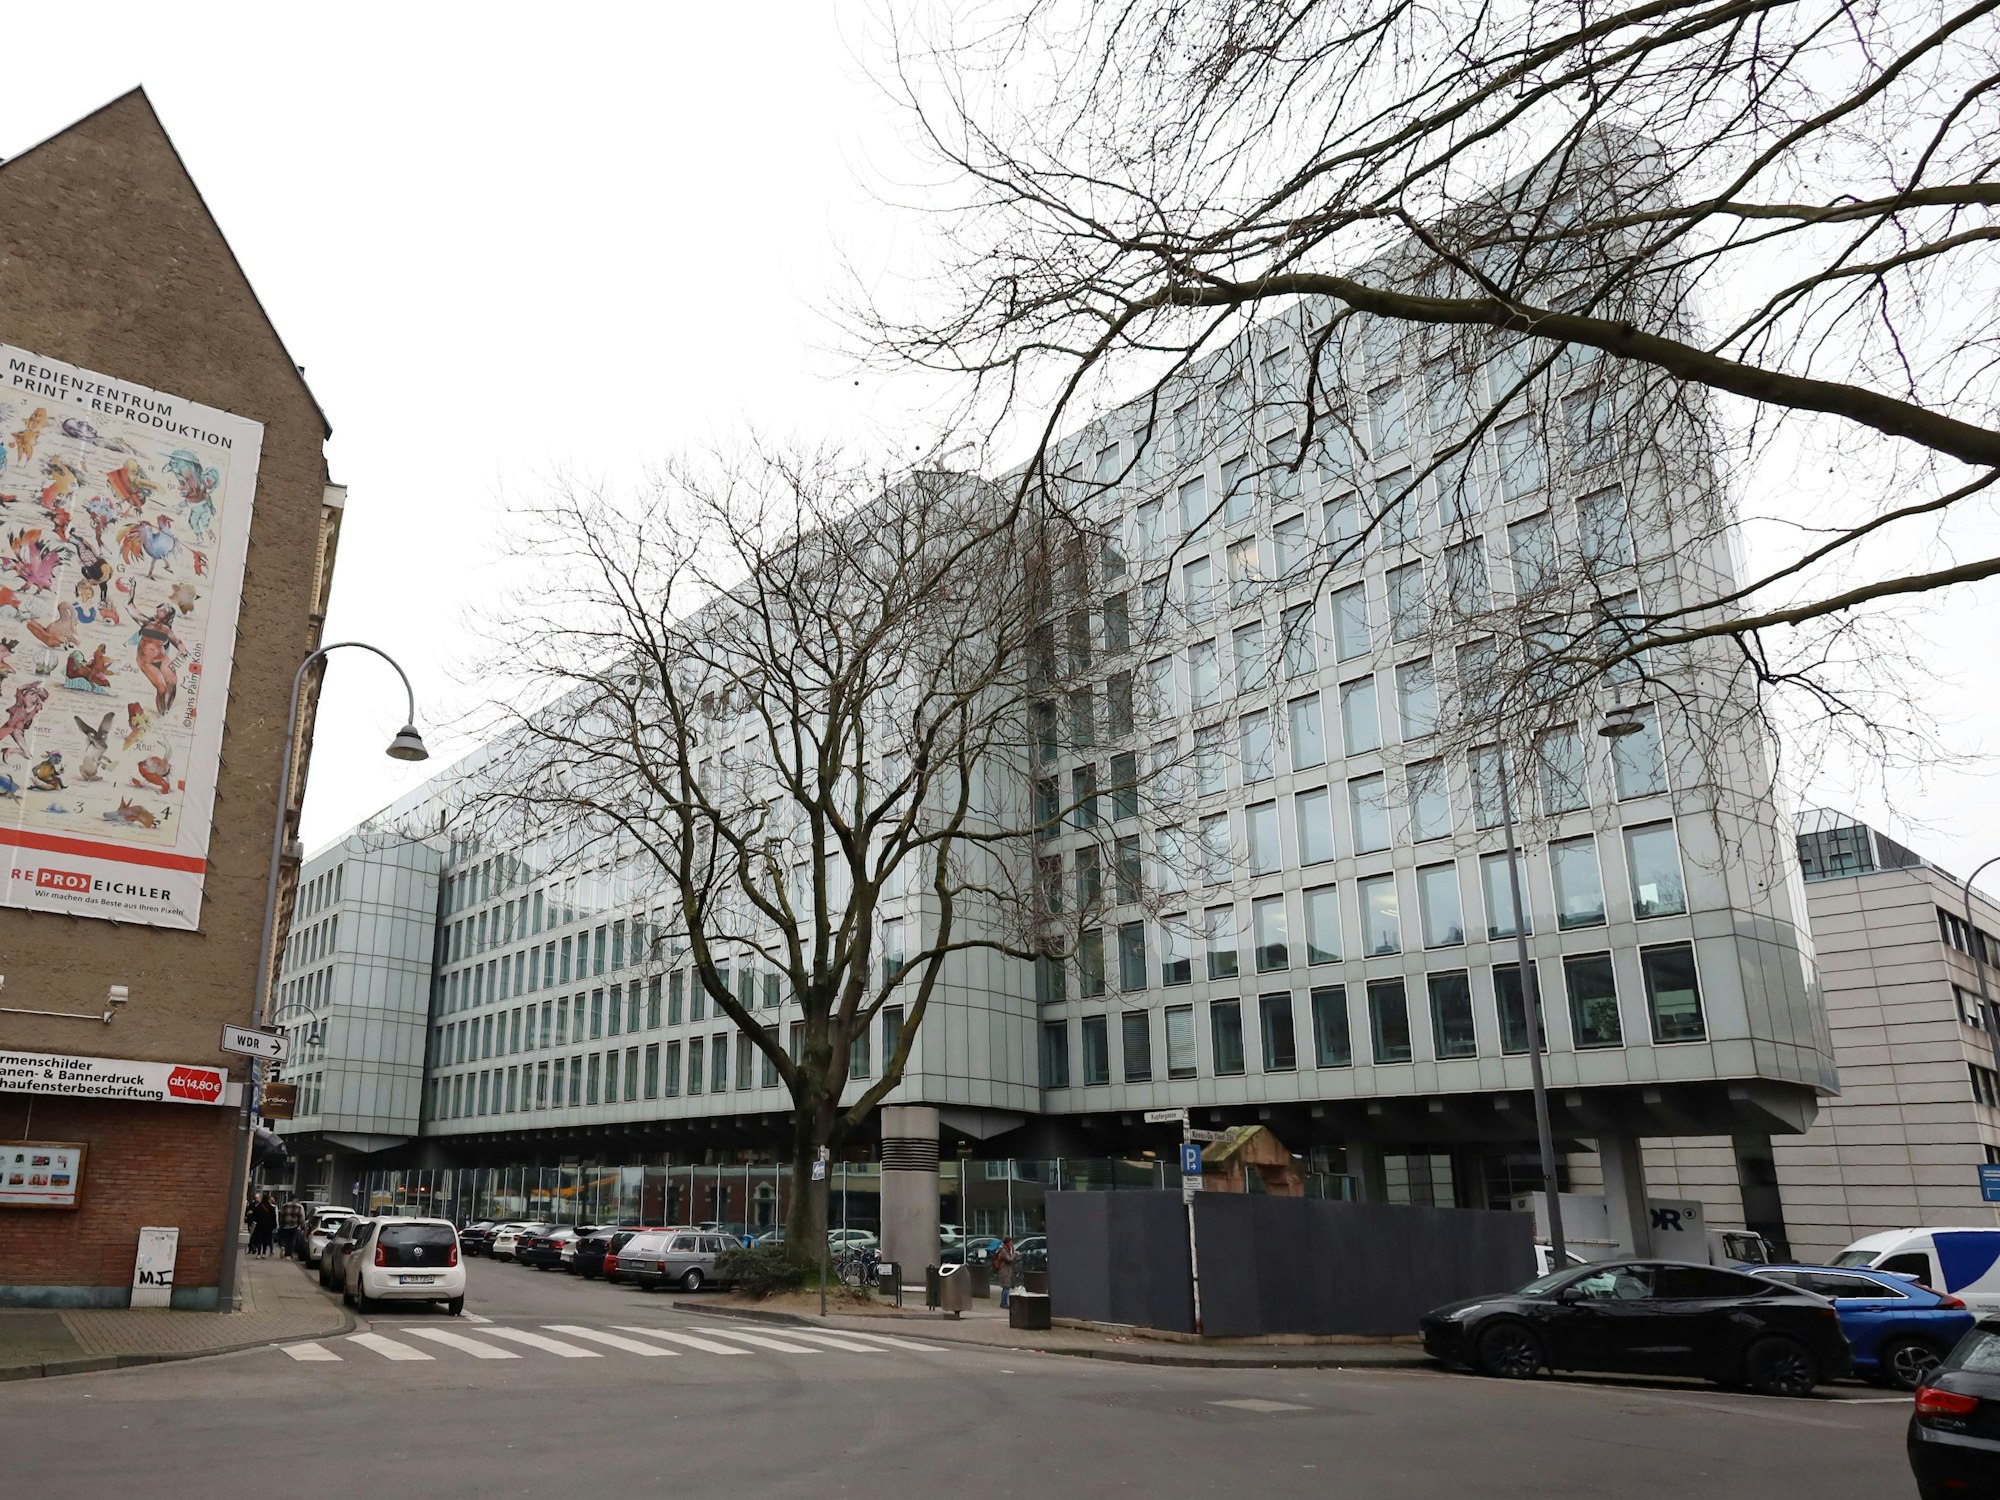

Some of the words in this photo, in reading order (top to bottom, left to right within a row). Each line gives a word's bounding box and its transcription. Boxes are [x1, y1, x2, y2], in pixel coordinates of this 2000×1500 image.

[9, 358, 173, 417] MEDIENZENTRUM
[12, 374, 69, 401] PRINT
[91, 399, 233, 449] REPRODUKTION
[192, 643, 202, 663] Köln
[188, 672, 198, 695] Palm
[161, 806, 172, 820] 4
[94, 880, 171, 900] EICHLER
[34, 890, 50, 898] Wir
[51, 892, 83, 902] machen
[85, 896, 99, 904] das
[101, 898, 122, 907] Beste
[139, 903, 159, 912] Ihren
[237, 1035, 259, 1048] WDR
[43, 1068, 54, 1079] &
[58, 1070, 144, 1085] Bannerdruck
[169, 1076, 185, 1087] ab
[0, 1078, 163, 1100] haufensterbeschriftung
[1186, 1149, 1196, 1170] P
